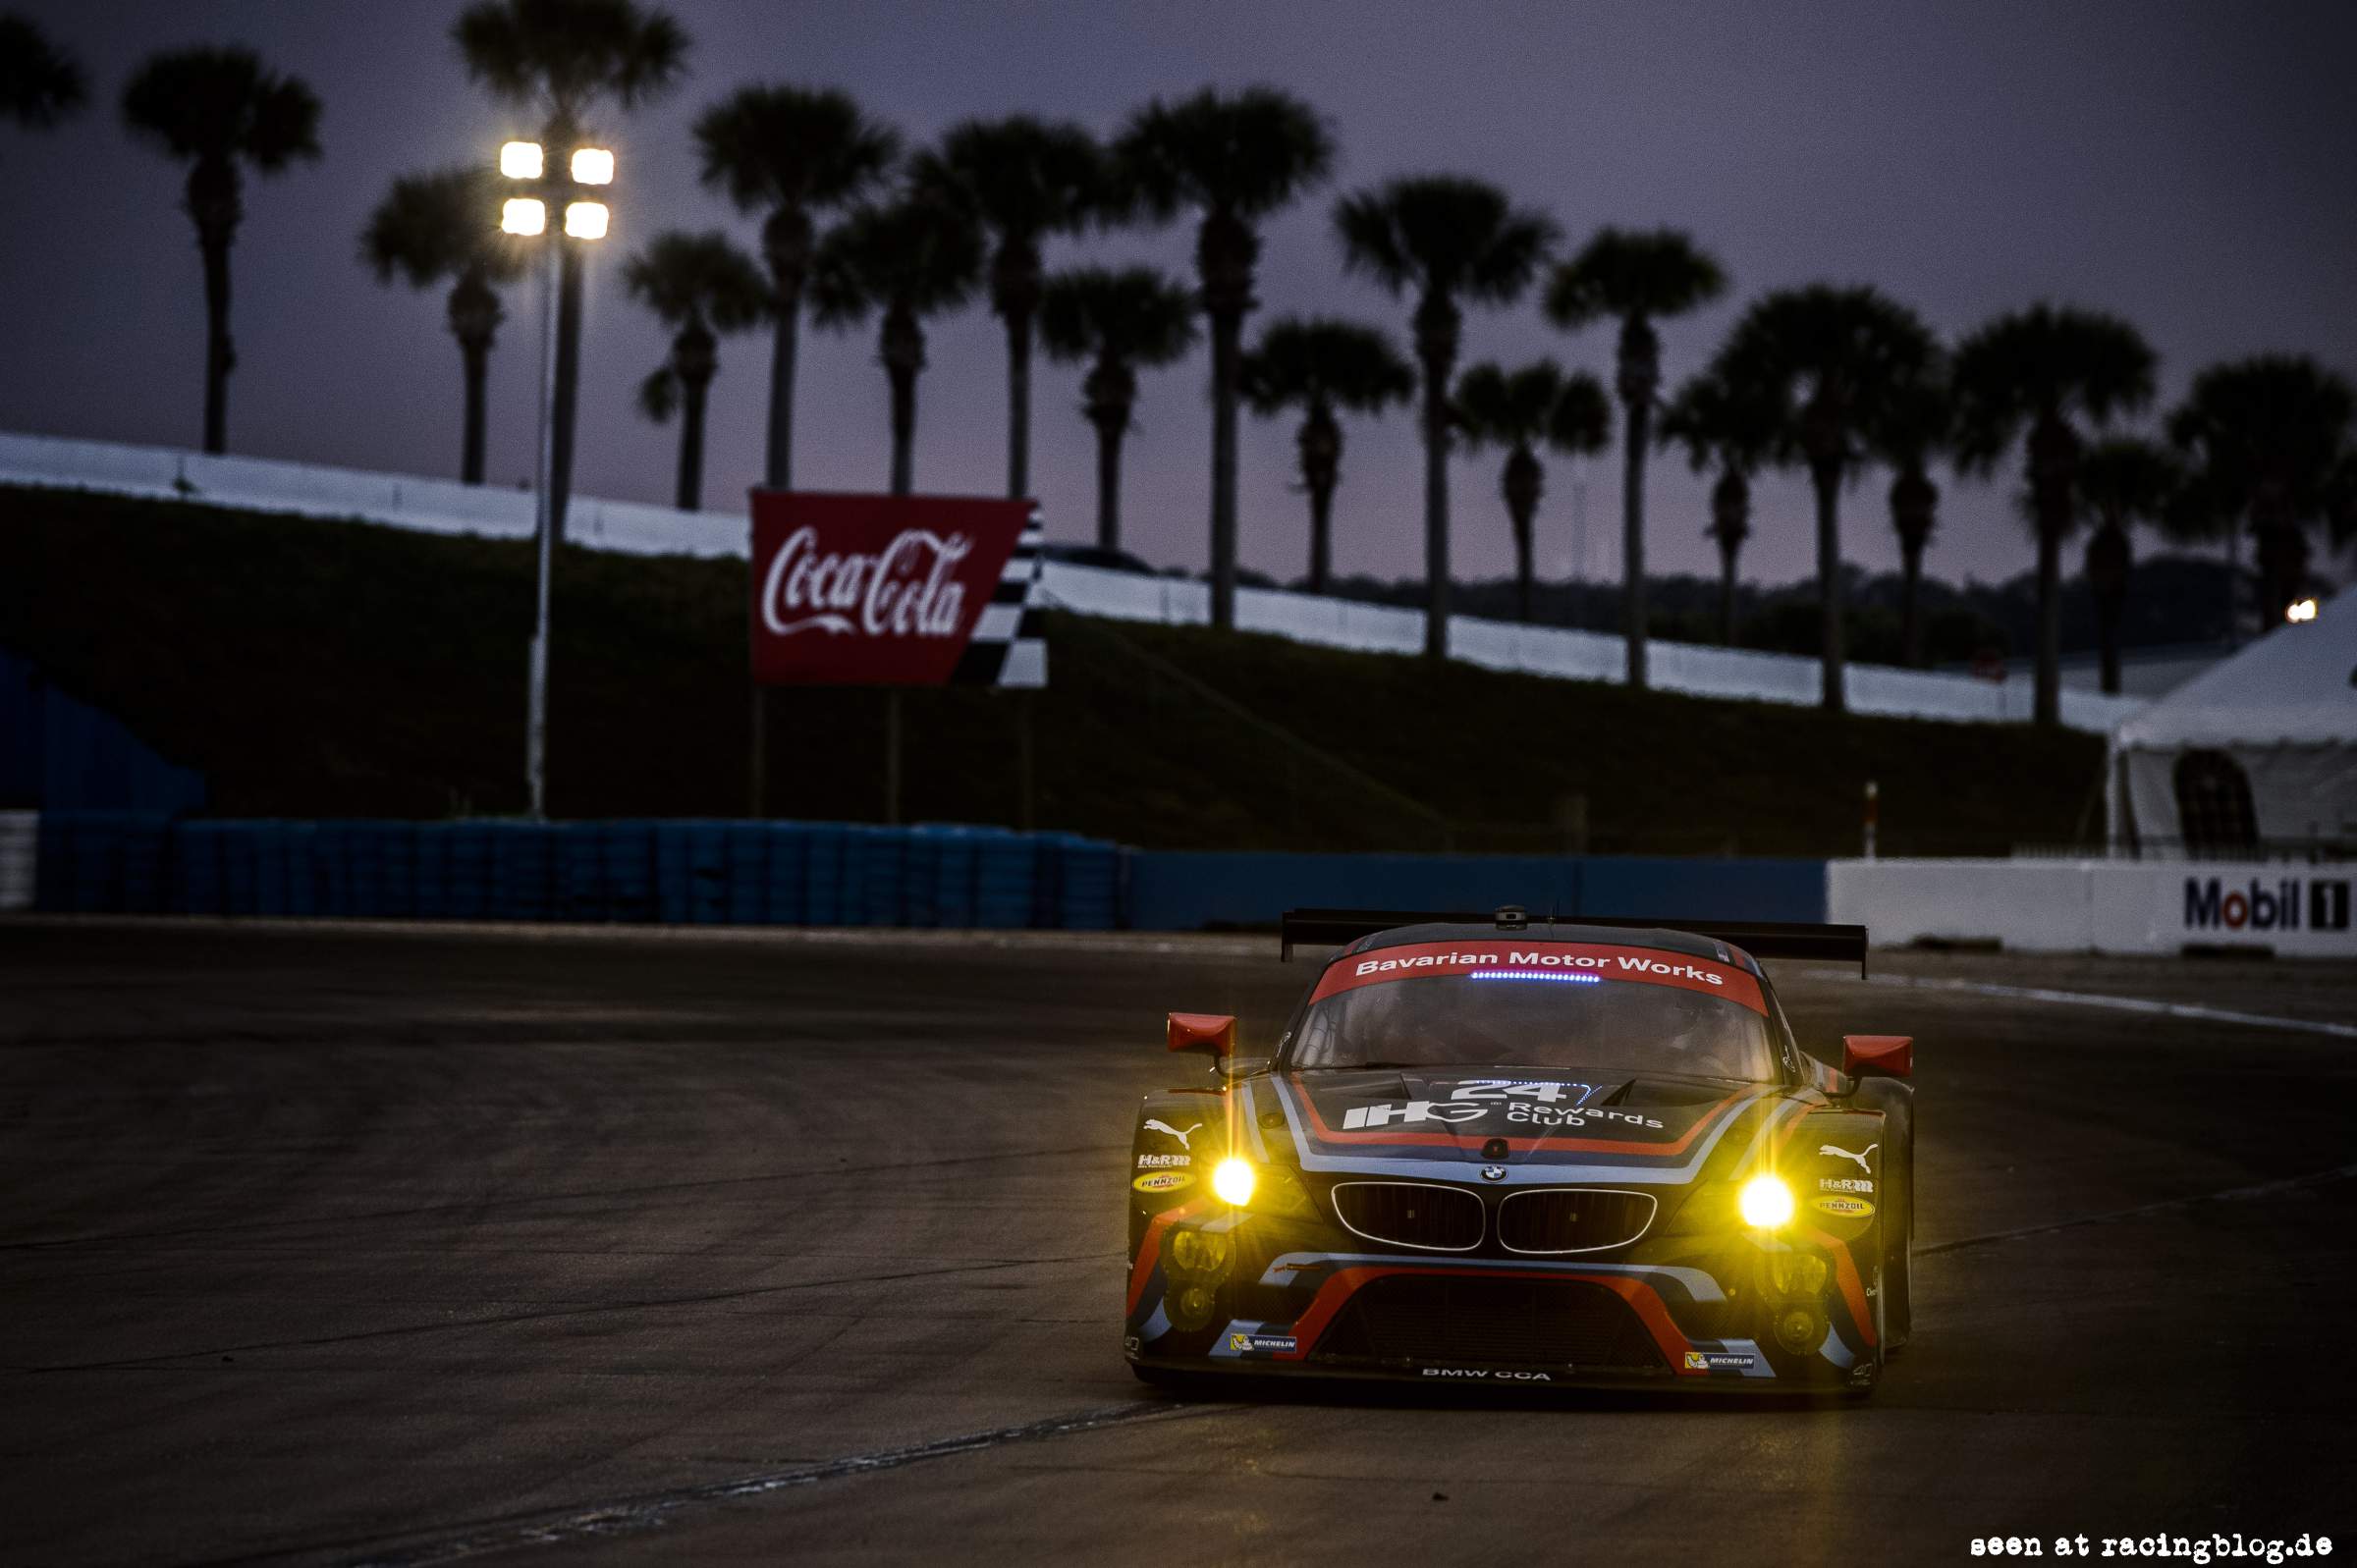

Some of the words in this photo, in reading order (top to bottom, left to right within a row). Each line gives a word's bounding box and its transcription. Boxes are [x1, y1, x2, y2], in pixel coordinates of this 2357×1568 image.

[760, 524, 974, 638] Coca-Cola
[2184, 877, 2300, 929] Mobil
[2315, 881, 2343, 928] 1
[1355, 951, 1499, 976] Bavarian
[1508, 951, 1611, 968] Motor
[1617, 955, 1724, 986] Works
[1450, 1078, 1568, 1104] 24
[1342, 1100, 1489, 1130] IHG
[1506, 1110, 1586, 1126] Club
[1507, 1102, 1665, 1130] Rewards
[1253, 1339, 1295, 1348] MICHELIN
[1422, 1368, 1488, 1377] BMW
[1495, 1371, 1552, 1380] CCA
